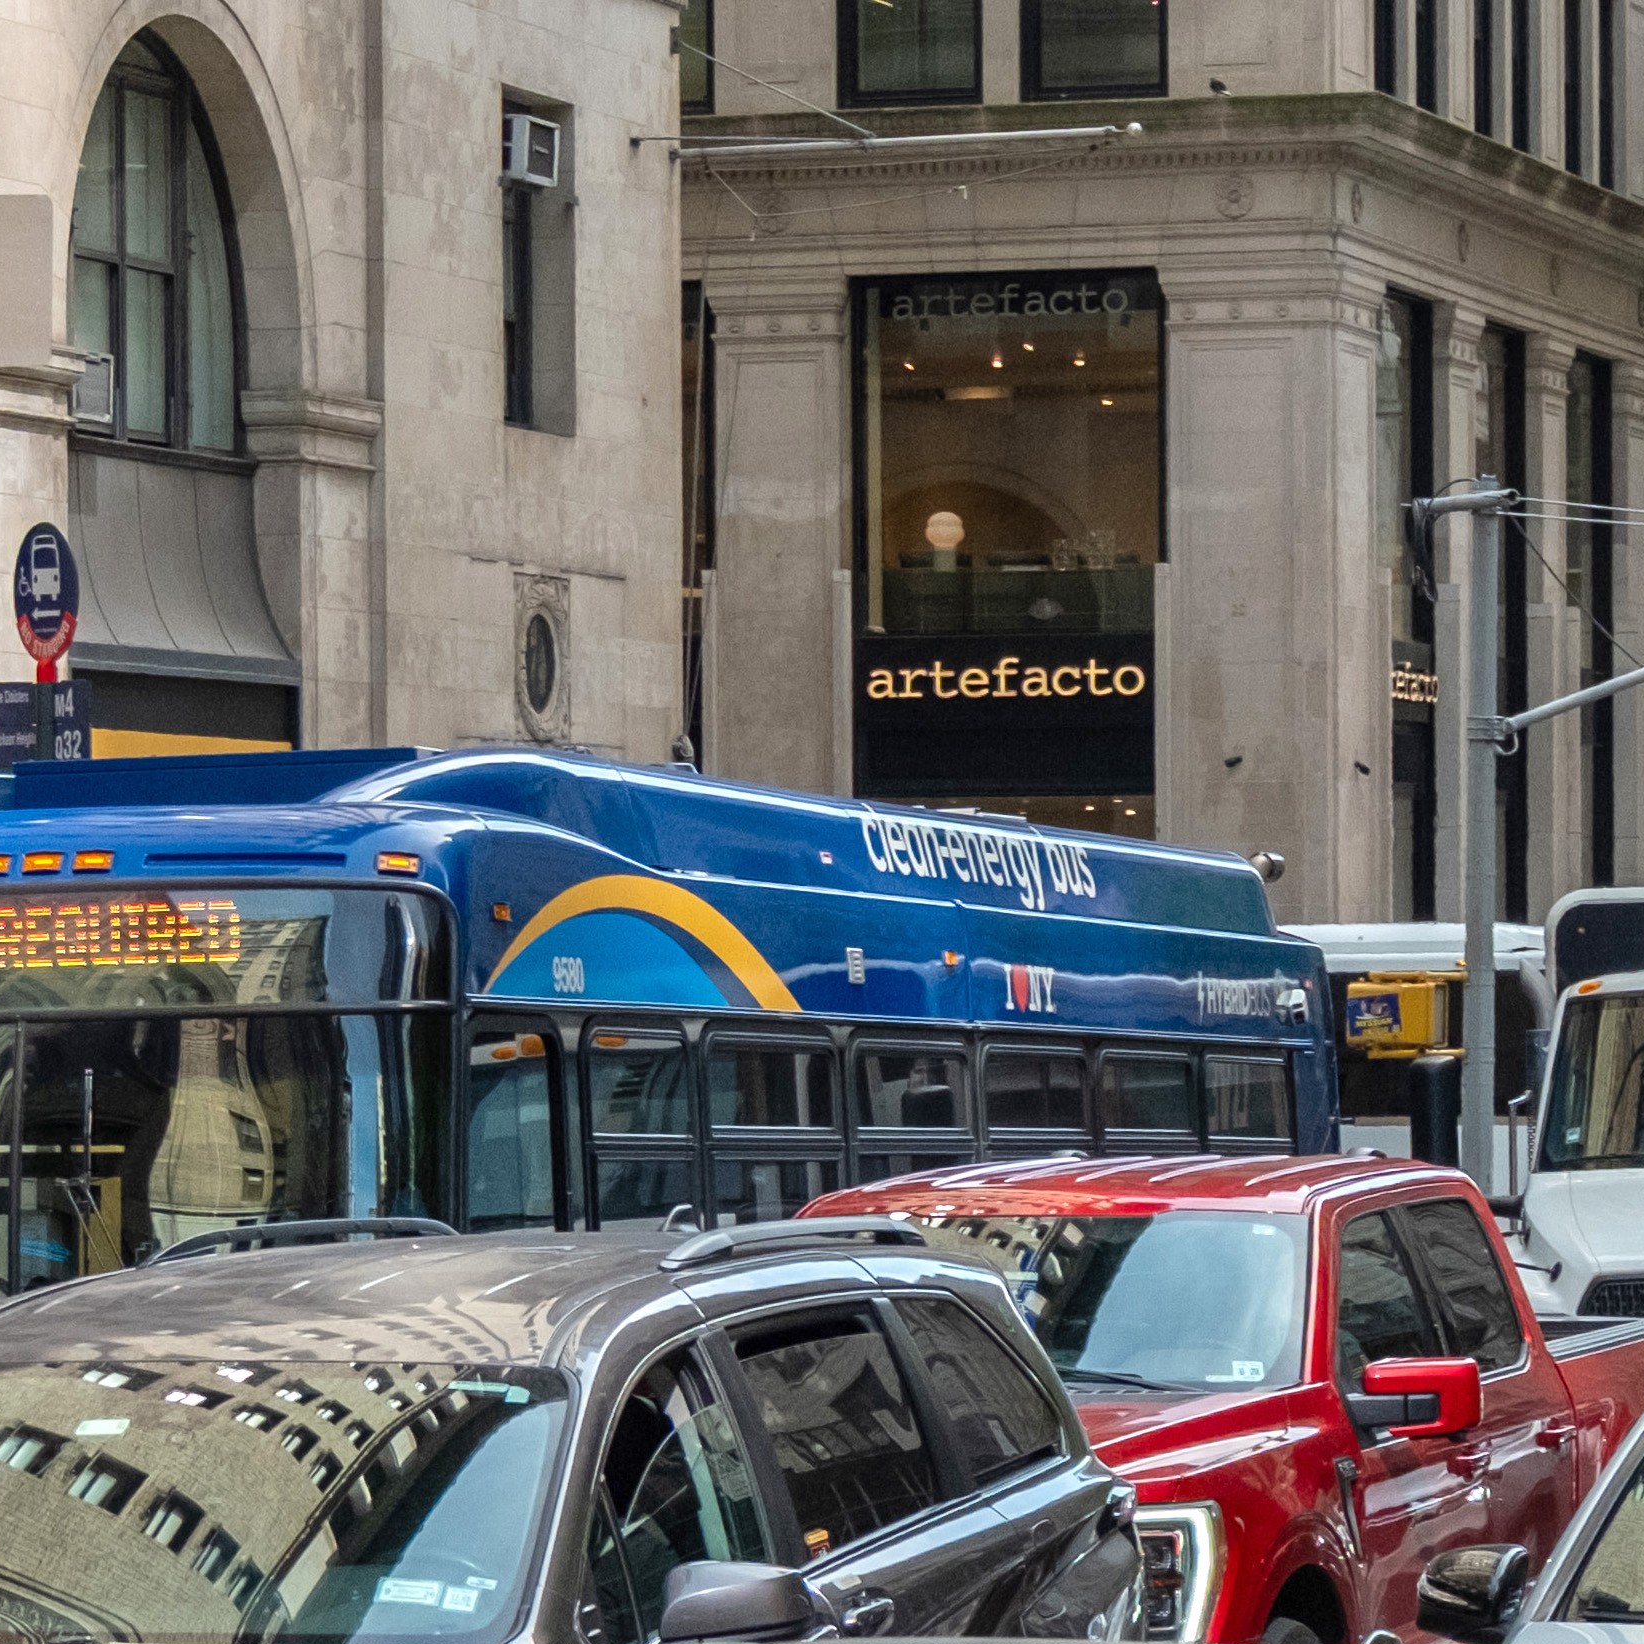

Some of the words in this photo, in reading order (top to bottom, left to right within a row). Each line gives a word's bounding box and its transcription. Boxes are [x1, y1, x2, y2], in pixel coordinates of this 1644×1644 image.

[892, 283, 1129, 320] artefacto
[866, 656, 1147, 700] artefacto
[54, 687, 75, 718] M4
[54, 729, 82, 760] Q32
[1029, 826, 1097, 898] bus
[552, 955, 585, 993] 9580
